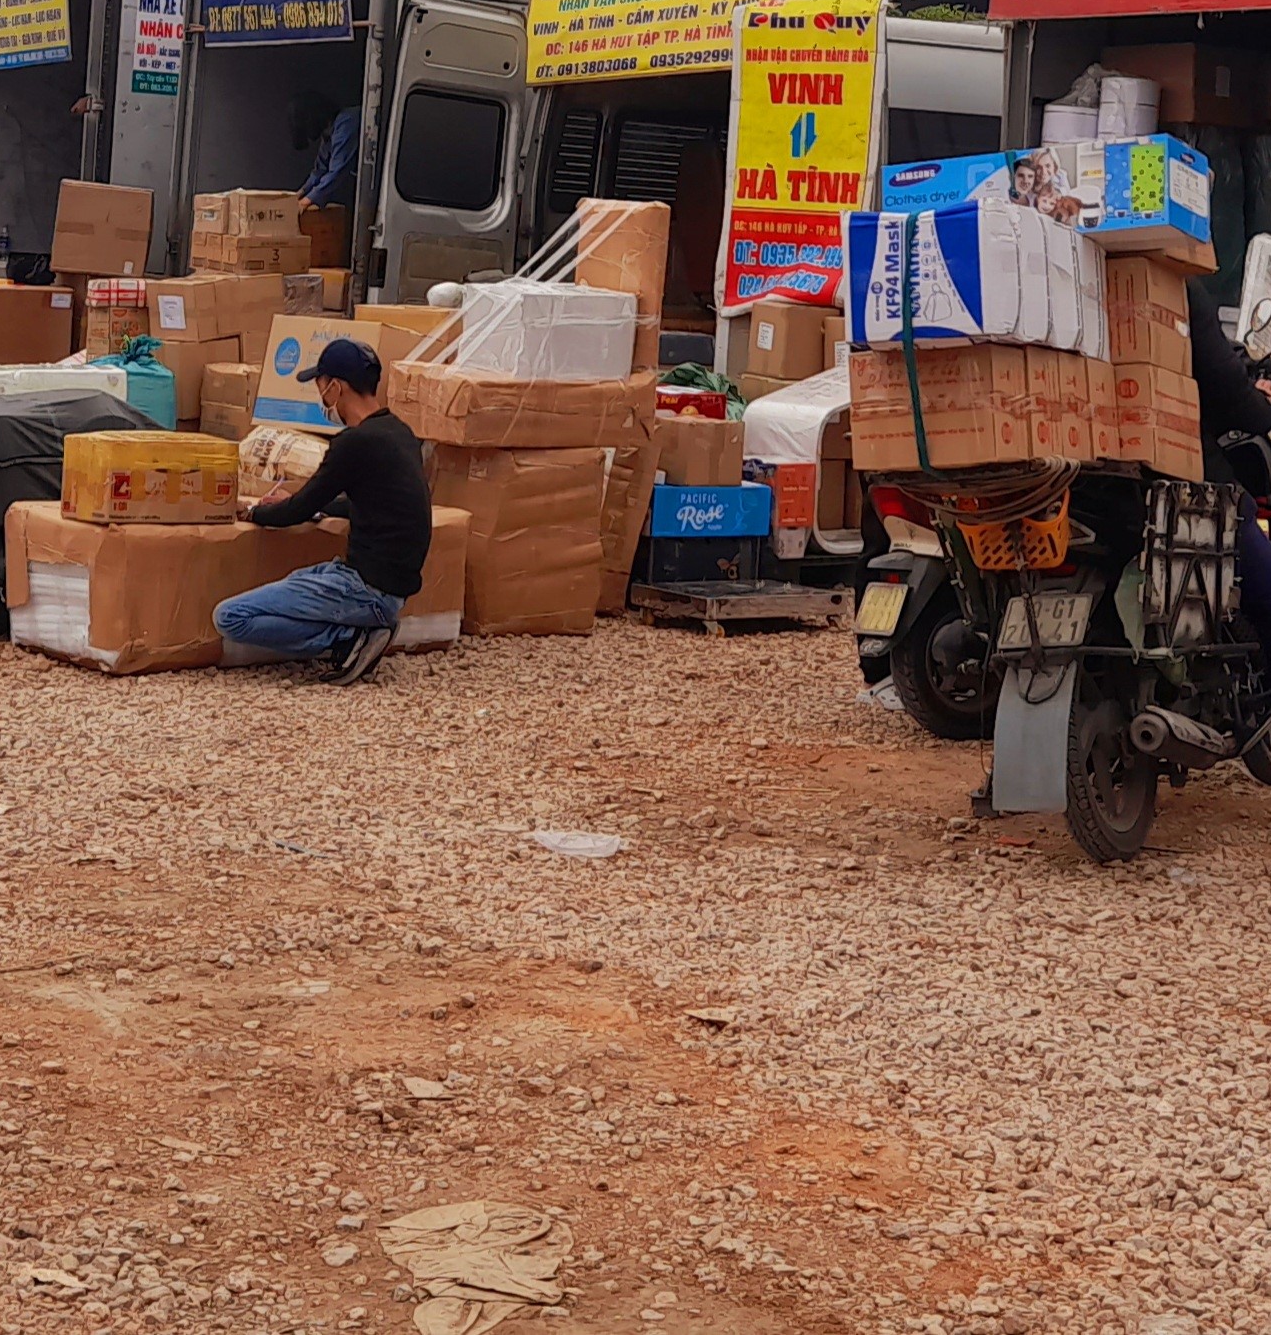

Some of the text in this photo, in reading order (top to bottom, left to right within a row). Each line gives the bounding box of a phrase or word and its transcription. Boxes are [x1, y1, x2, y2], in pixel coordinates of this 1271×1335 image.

[140, 19, 173, 41] NHẬN
[533, 21, 559, 36] VINH
[569, 16, 584, 32] HÀ
[657, 3, 698, 22] XUYÊN
[748, 11, 805, 29] Phú
[546, 23, 701, 56] ĐC: 146 HÀ HUY TẬP TP. HÀ
[536, 65, 554, 78] ĐT:
[558, 57, 638, 77] 0913803068
[768, 73, 844, 105] VINH
[737, 162, 861, 204] HÀ TĨNH
[895, 169, 936, 182] SAMSUNG
[885, 189, 961, 207] Clothes dryer
[734, 240, 757, 265] ĐT:
[885, 220, 901, 319] KF94 Mask
[681, 493, 718, 504] PACIFIC
[676, 504, 726, 532] Rose
